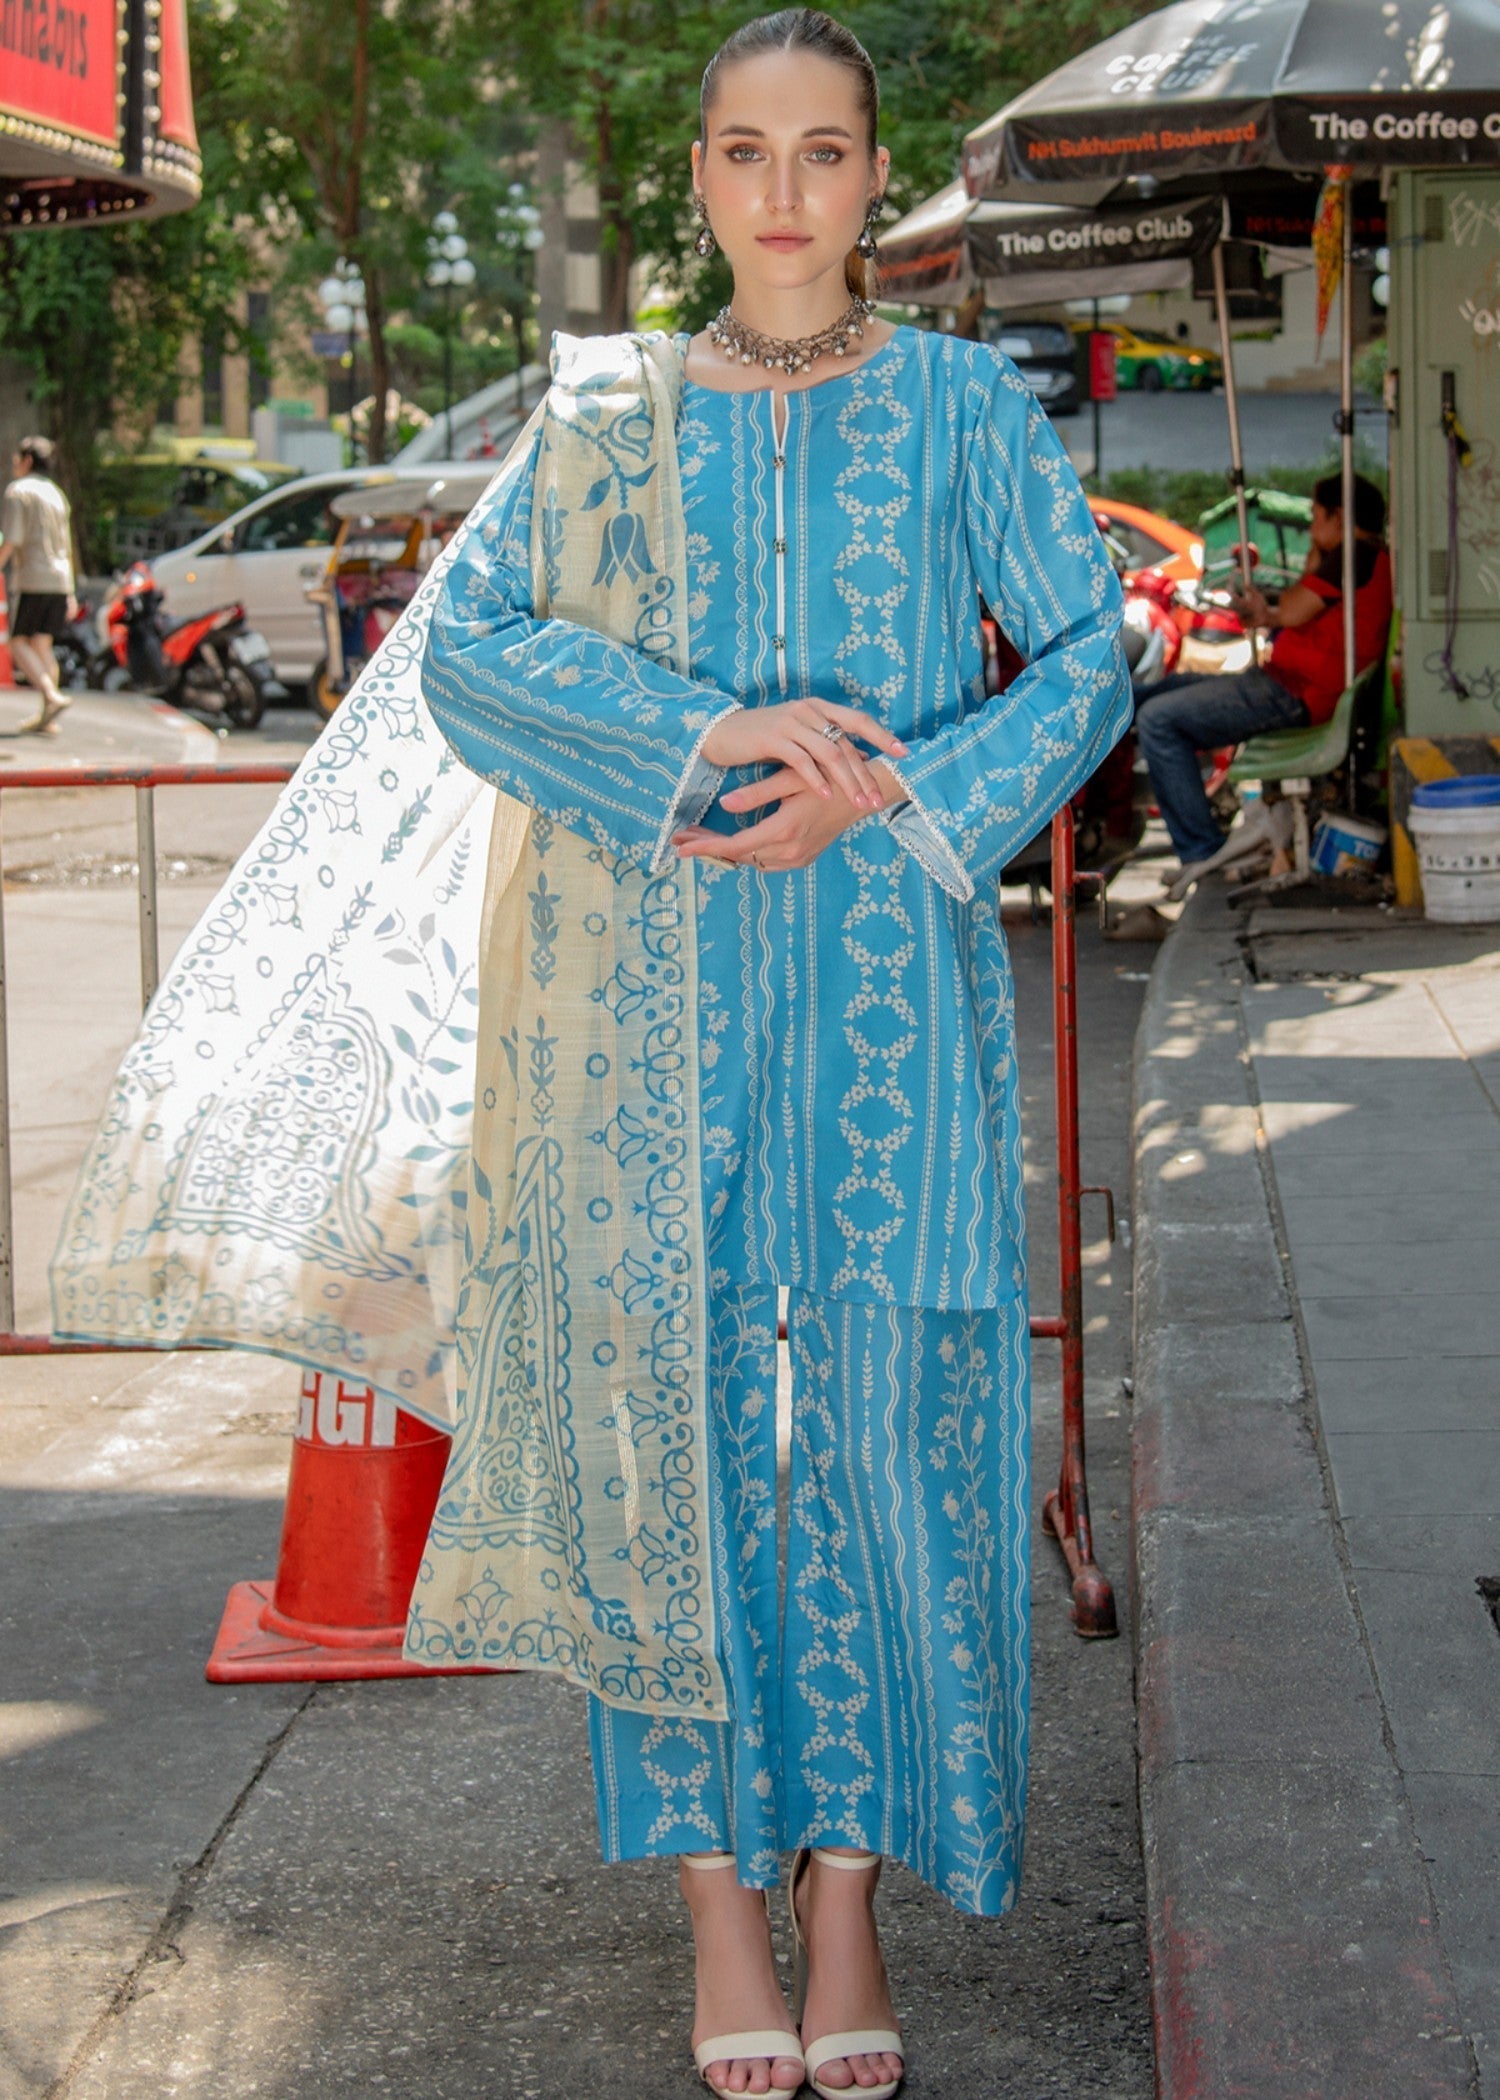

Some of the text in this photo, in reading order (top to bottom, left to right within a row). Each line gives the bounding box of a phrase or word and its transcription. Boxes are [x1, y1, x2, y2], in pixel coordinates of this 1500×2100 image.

[1105, 42, 1258, 75] COFFEE
[1110, 69, 1214, 94] CLUB
[1059, 132, 1157, 158] Sukhumvit
[1160, 121, 1257, 149] Boulevard
[1309, 111, 1368, 140] The
[1372, 111, 1478, 140] Coffee
[997, 213, 1194, 256] The Coffee Club
